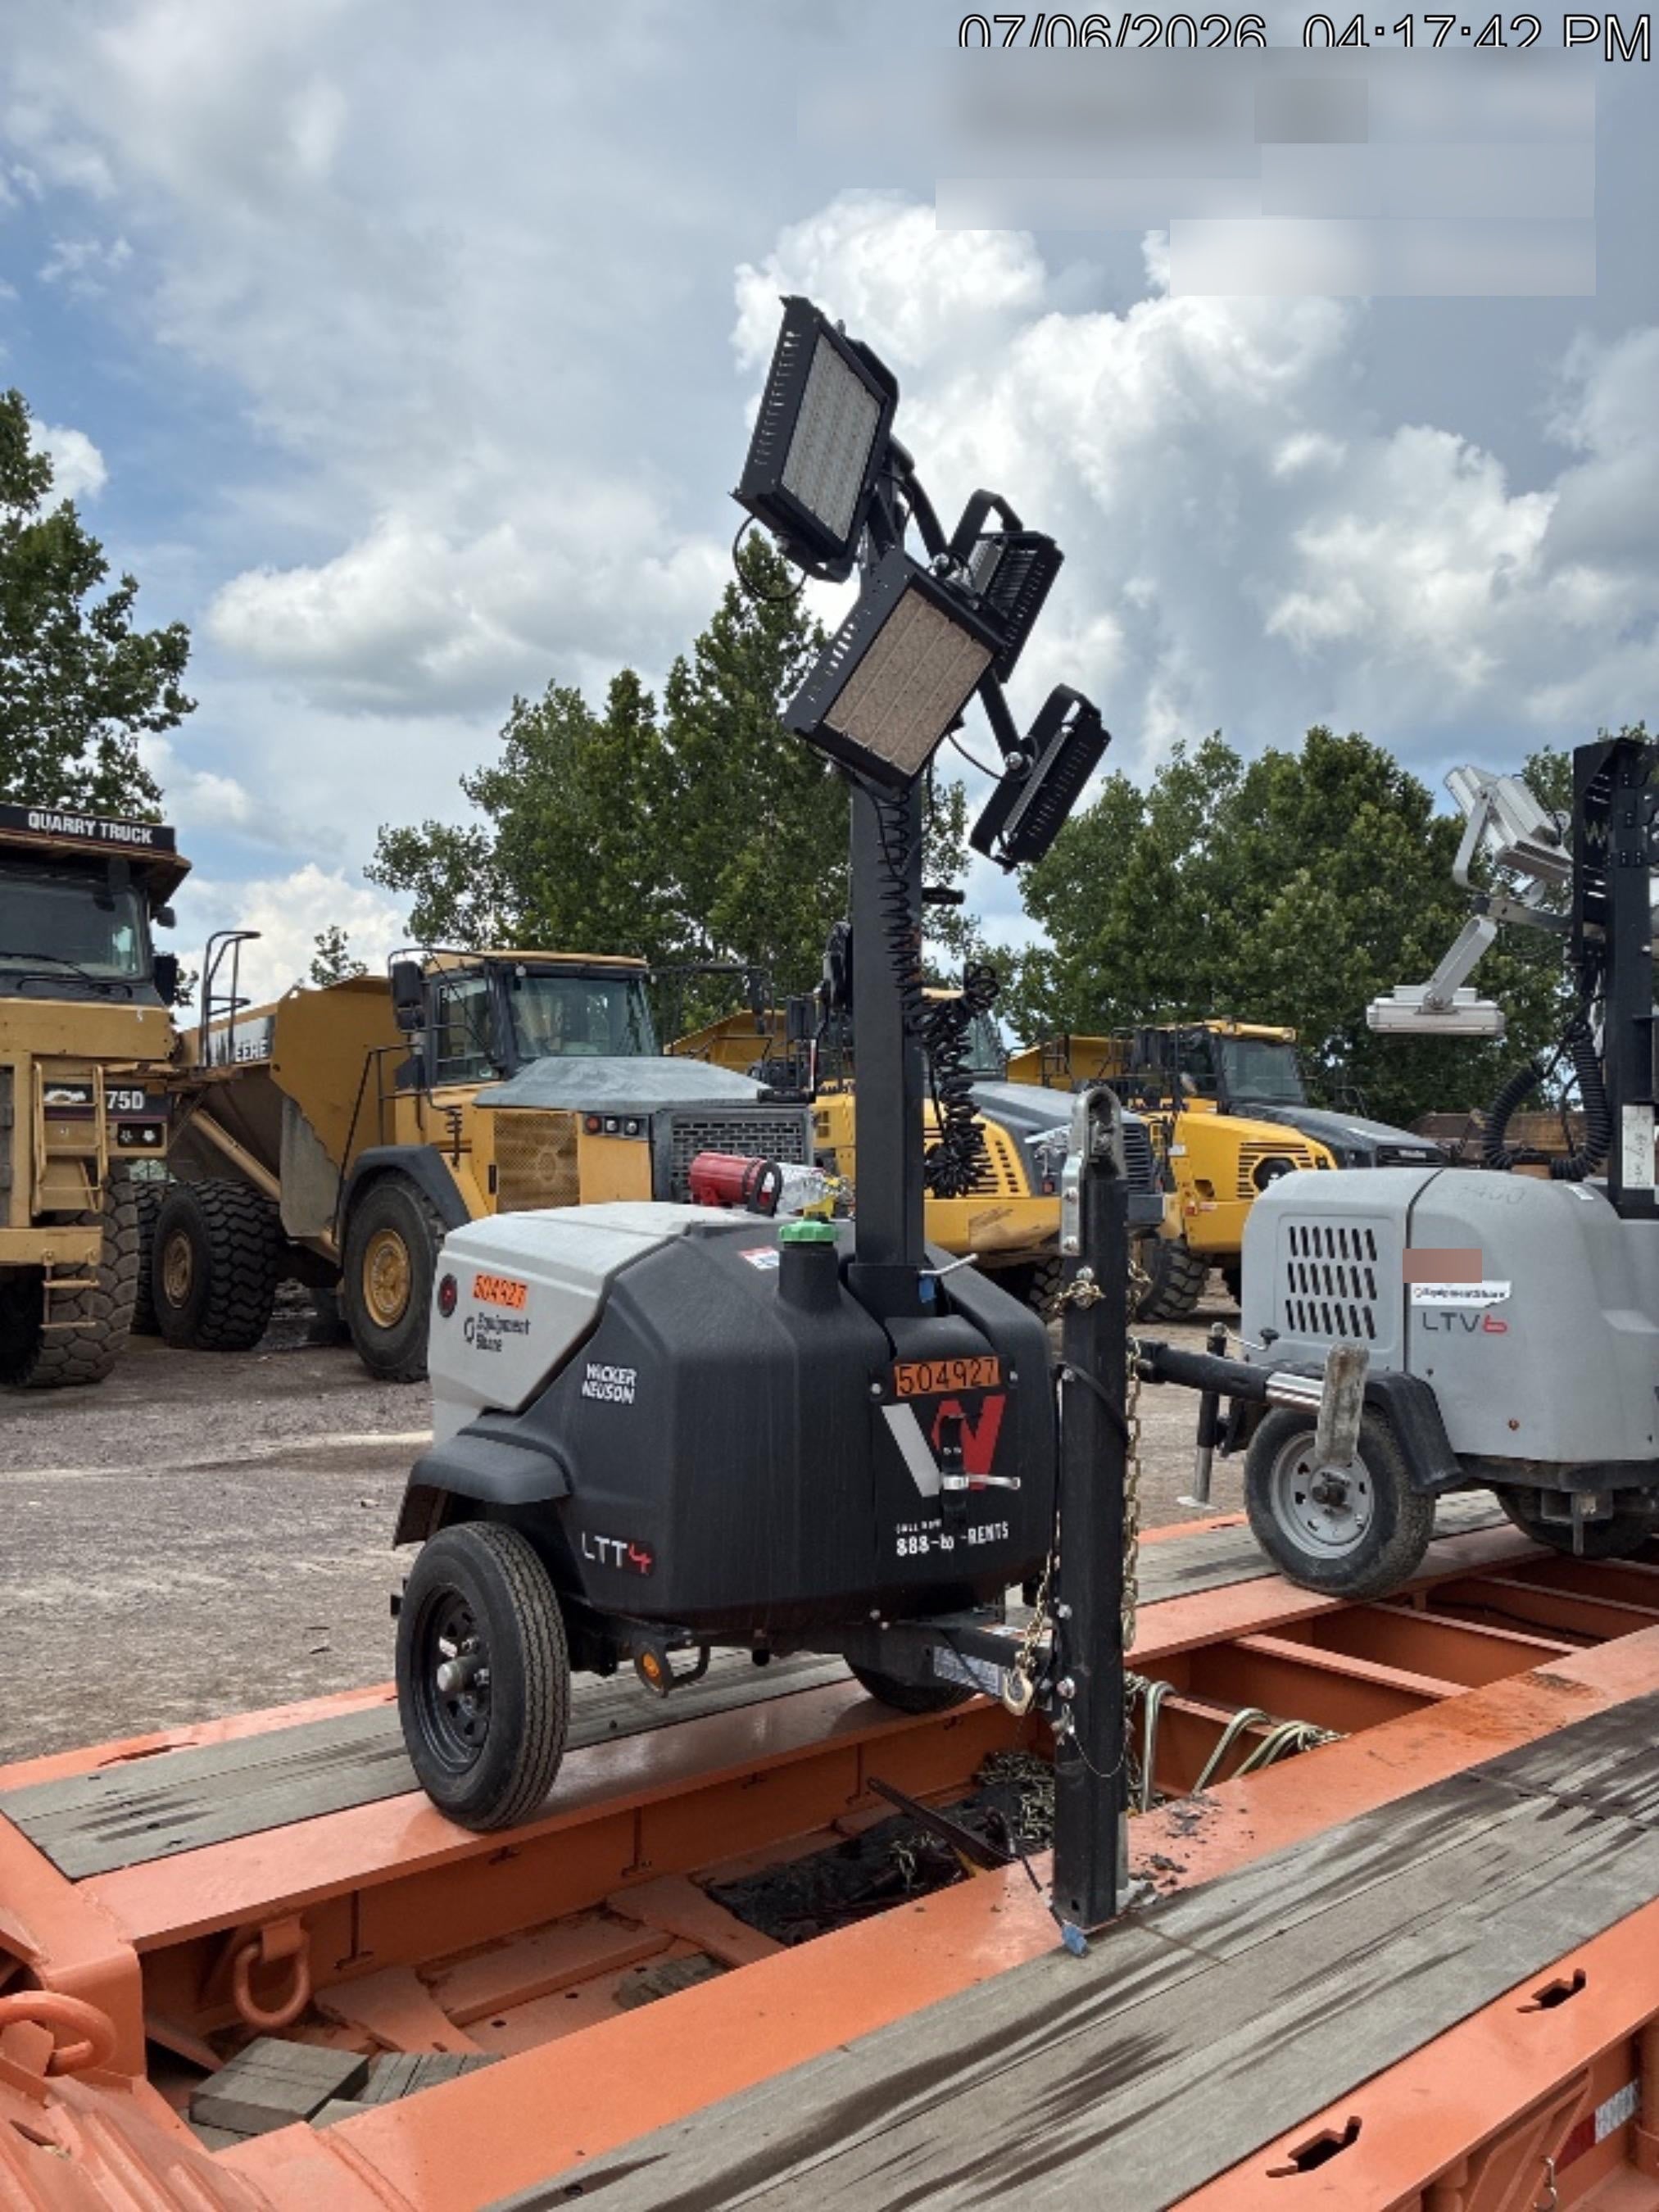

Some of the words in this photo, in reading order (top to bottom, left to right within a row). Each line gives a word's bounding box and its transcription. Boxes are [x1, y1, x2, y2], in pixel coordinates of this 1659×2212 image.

[28, 811, 96, 837] QUARRY
[99, 822, 153, 844] TRUCK
[1422, 1311, 1508, 1334] LTV6
[581, 1380, 635, 1404] NEUSON
[898, 1358, 995, 1394] 504927
[581, 1530, 652, 1575] LTT4
